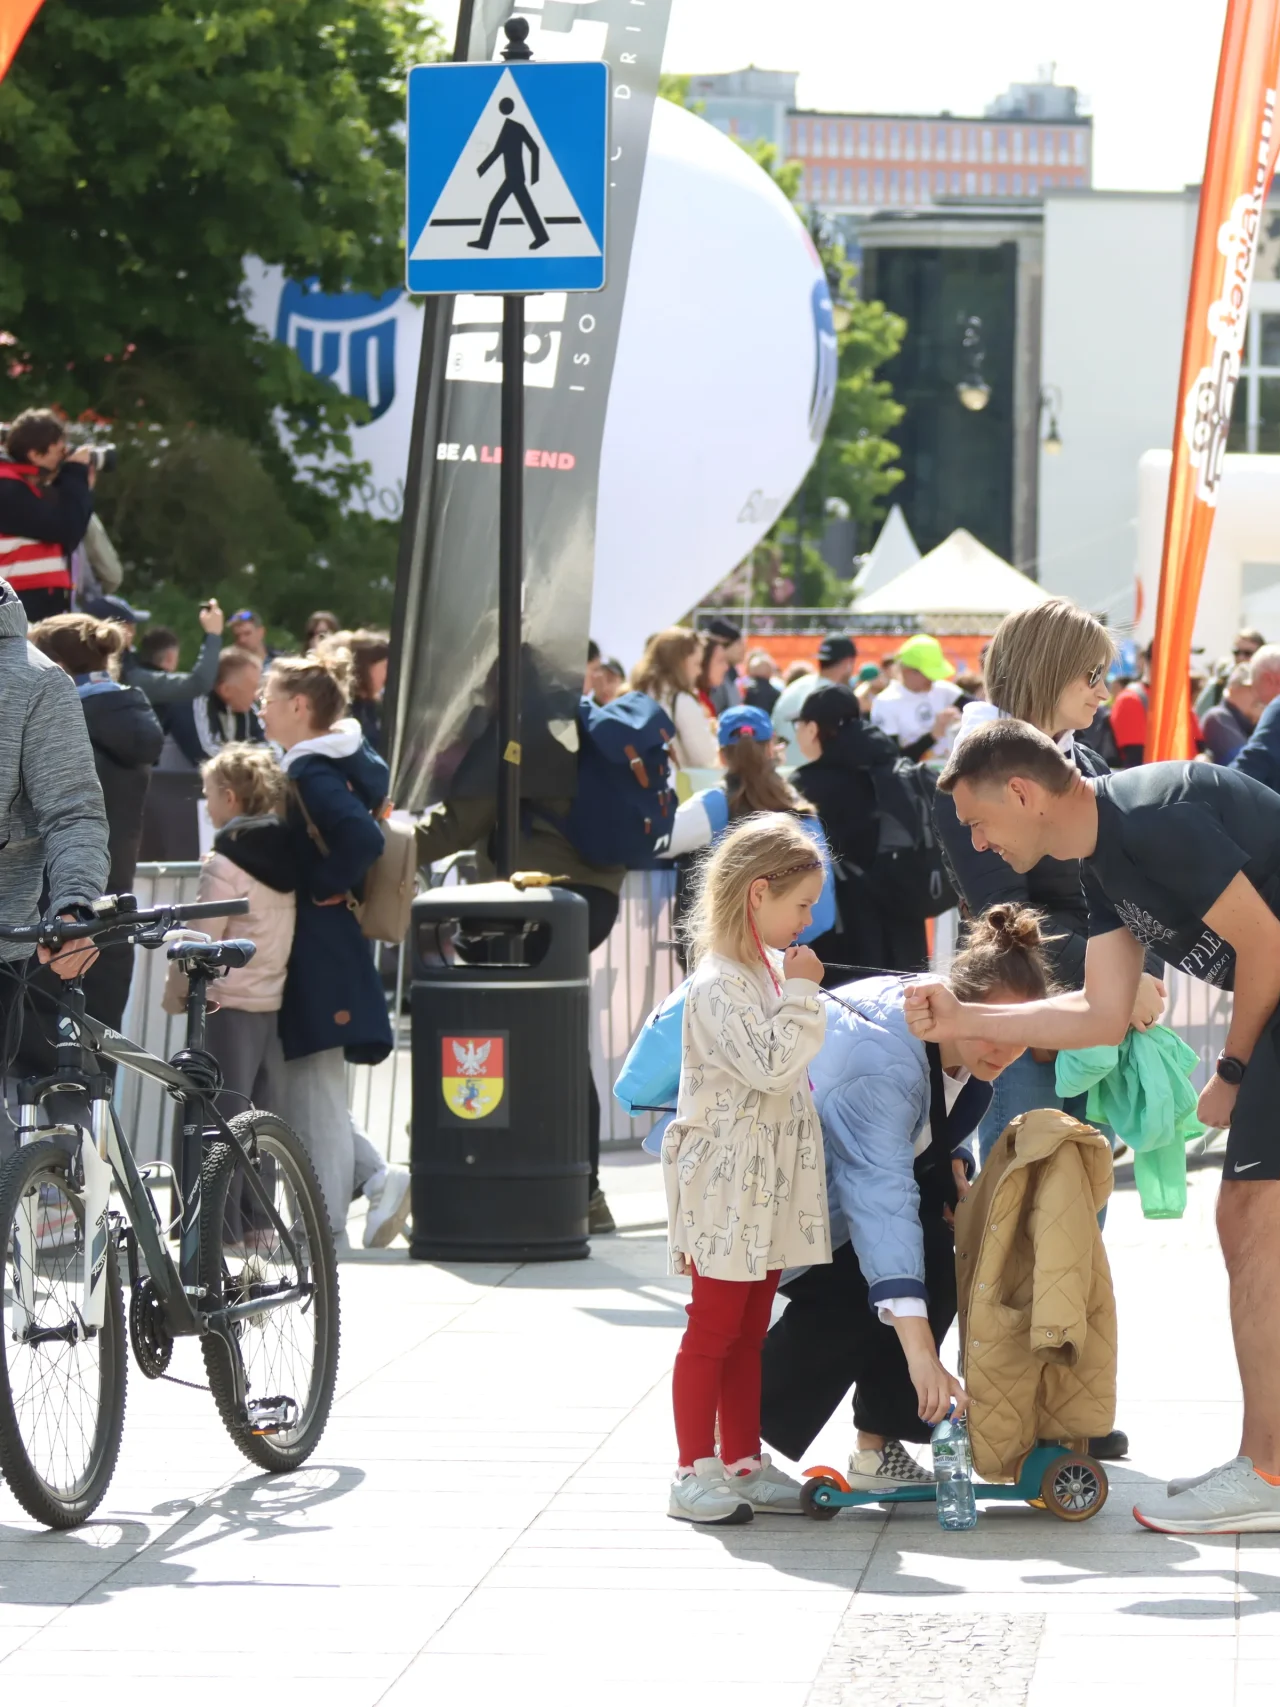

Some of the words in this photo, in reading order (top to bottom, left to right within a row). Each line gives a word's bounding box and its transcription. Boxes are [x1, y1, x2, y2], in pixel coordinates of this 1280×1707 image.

[613, 0, 646, 100] DRI
[436, 442, 461, 461] BE
[461, 444, 478, 462] A
[480, 445, 576, 470] LEEND
